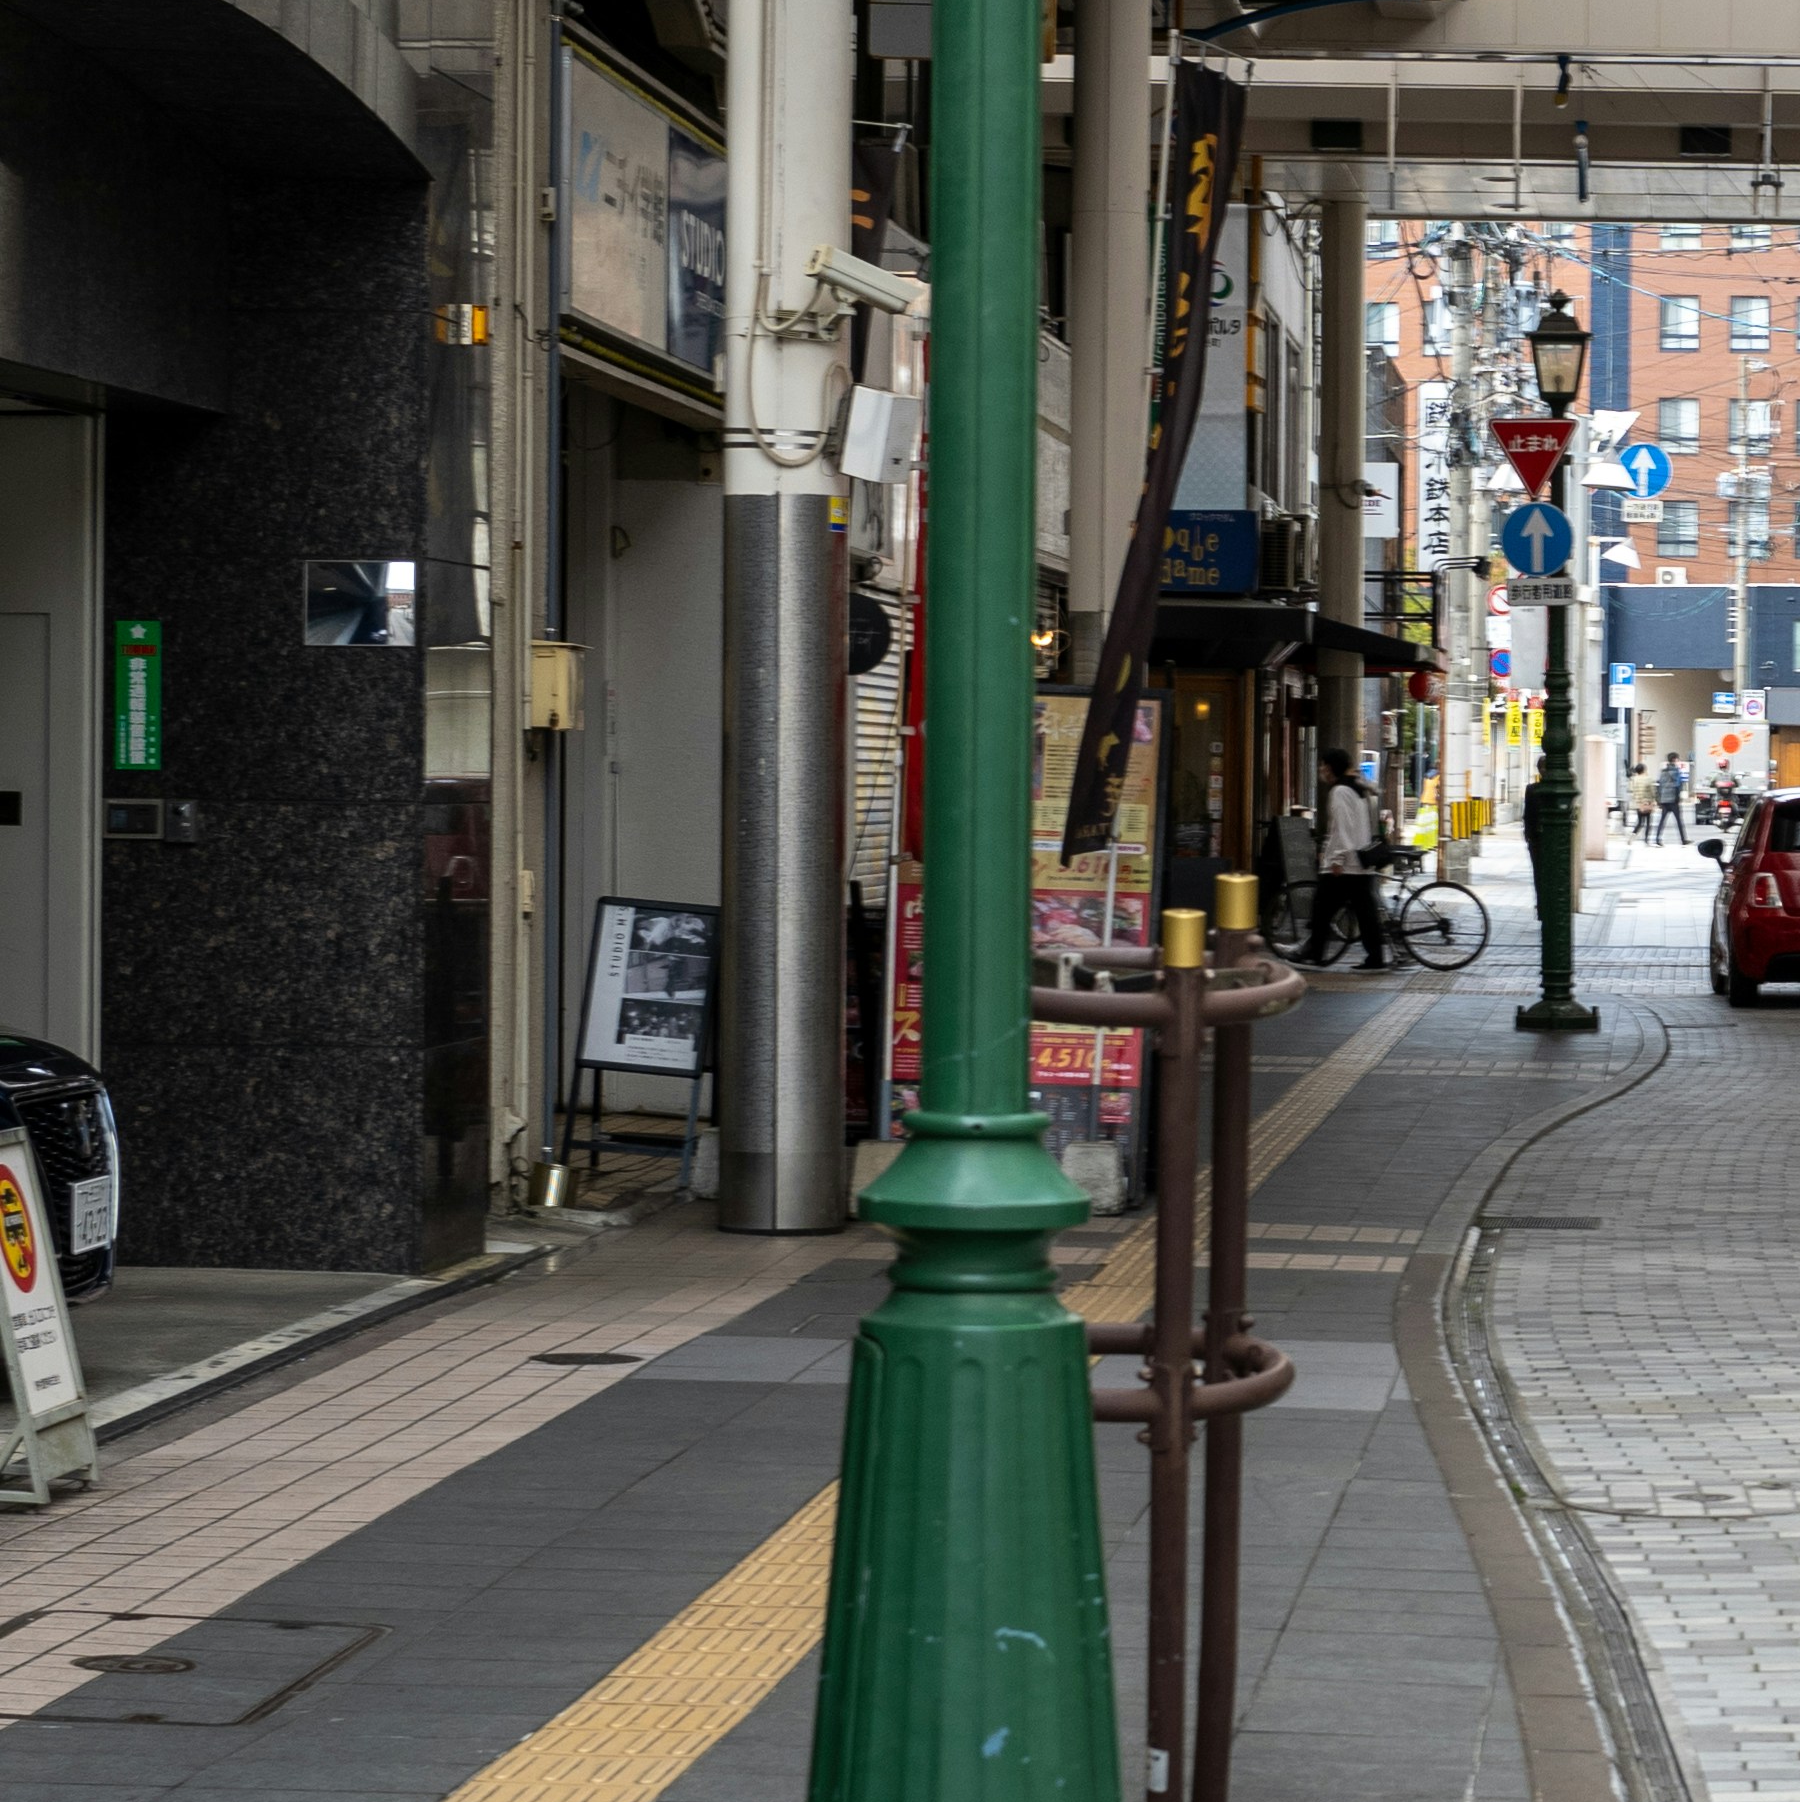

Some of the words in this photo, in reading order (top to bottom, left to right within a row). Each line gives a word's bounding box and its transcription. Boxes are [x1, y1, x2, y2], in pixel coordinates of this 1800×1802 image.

[681, 209, 727, 288] STUDIO
[1507, 434, 1560, 453] 止まれ
[1617, 665, 1632, 683] P
[607, 932, 626, 978] STUDIO
